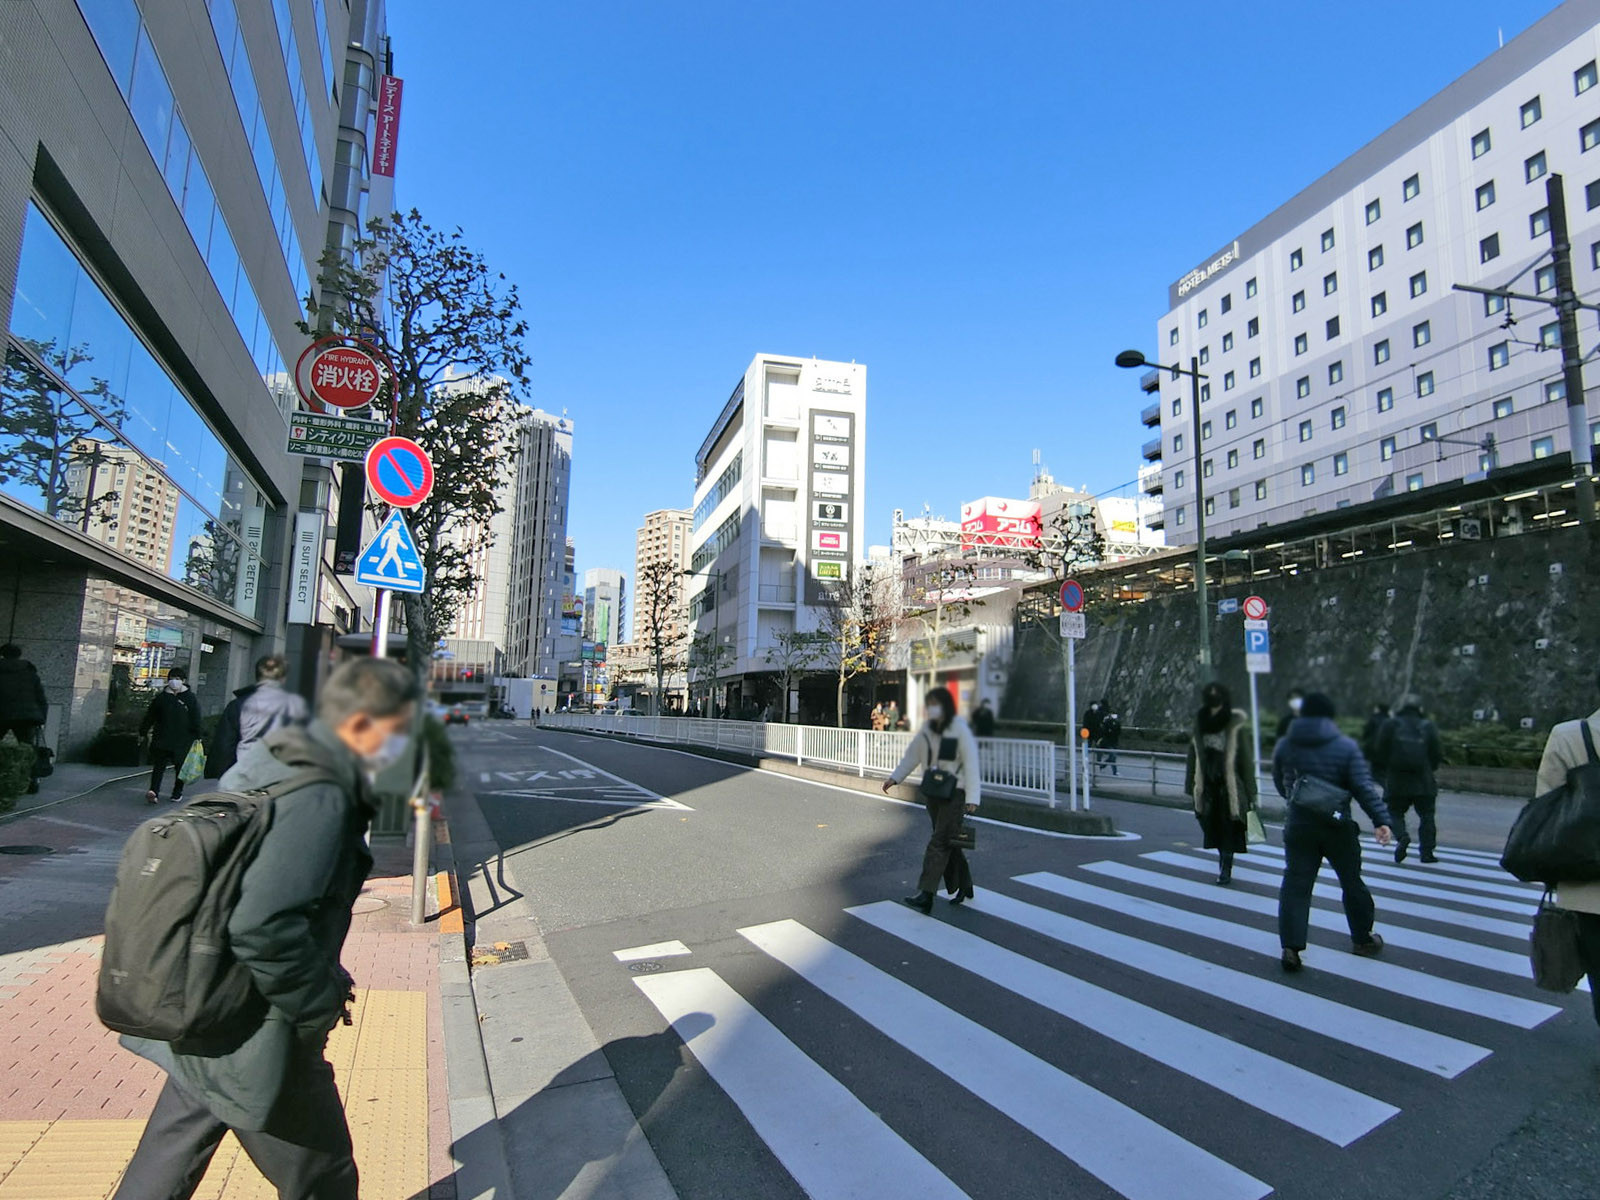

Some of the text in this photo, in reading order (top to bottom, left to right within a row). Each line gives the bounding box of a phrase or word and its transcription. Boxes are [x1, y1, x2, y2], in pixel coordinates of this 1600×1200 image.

[1178, 271, 1207, 297] HOTEL
[1207, 251, 1234, 277] METS
[324, 354, 370, 366] FIRE HYDRANT
[316, 363, 375, 393] 消火栓
[308, 428, 382, 448] シティクリニッ
[996, 517, 1032, 534] アコム
[297, 545, 311, 604] SUIT SELECT
[1250, 632, 1265, 651] P
